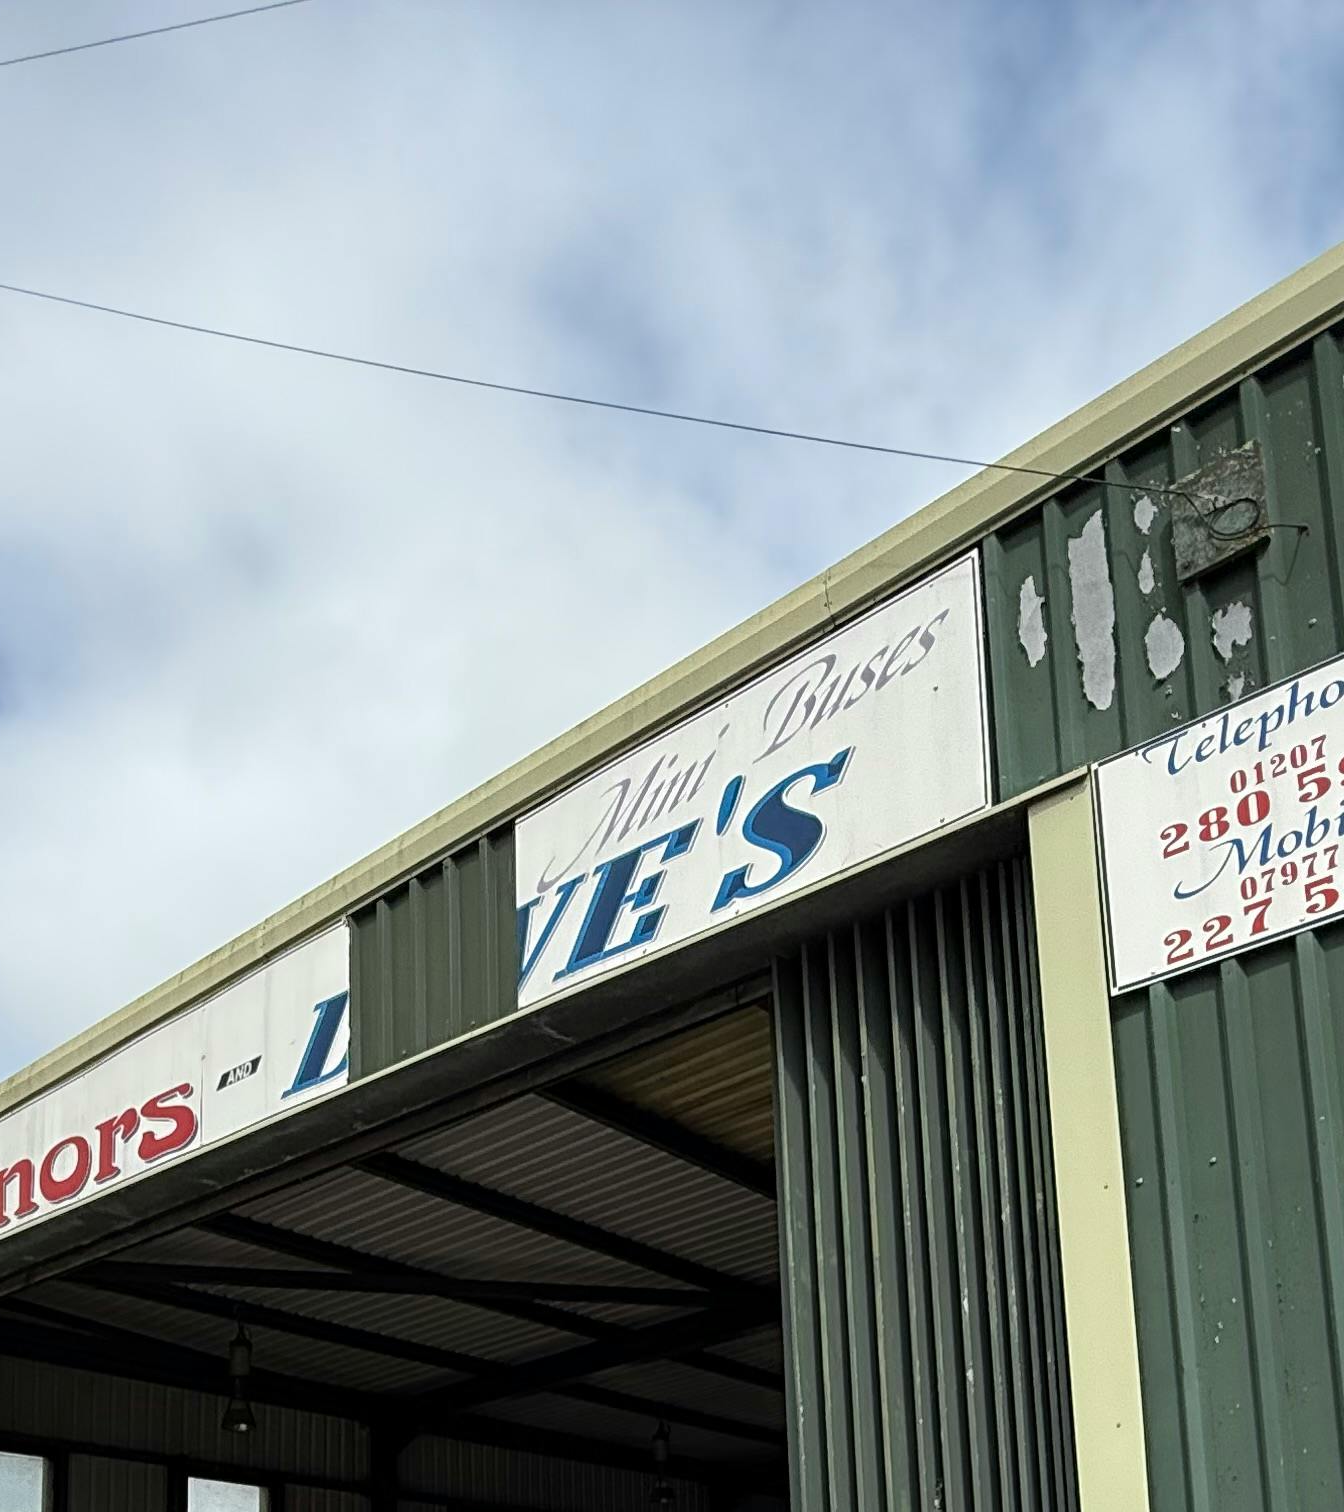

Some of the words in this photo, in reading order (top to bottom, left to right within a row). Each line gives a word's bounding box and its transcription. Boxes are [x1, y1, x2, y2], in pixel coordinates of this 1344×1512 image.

[536, 722, 731, 896] Mini
[753, 607, 950, 764] Buses
[1230, 734, 1327, 794] 01207
[1160, 790, 1271, 859] 280
[1240, 844, 1339, 901] 07977
[1163, 897, 1273, 965] 227
